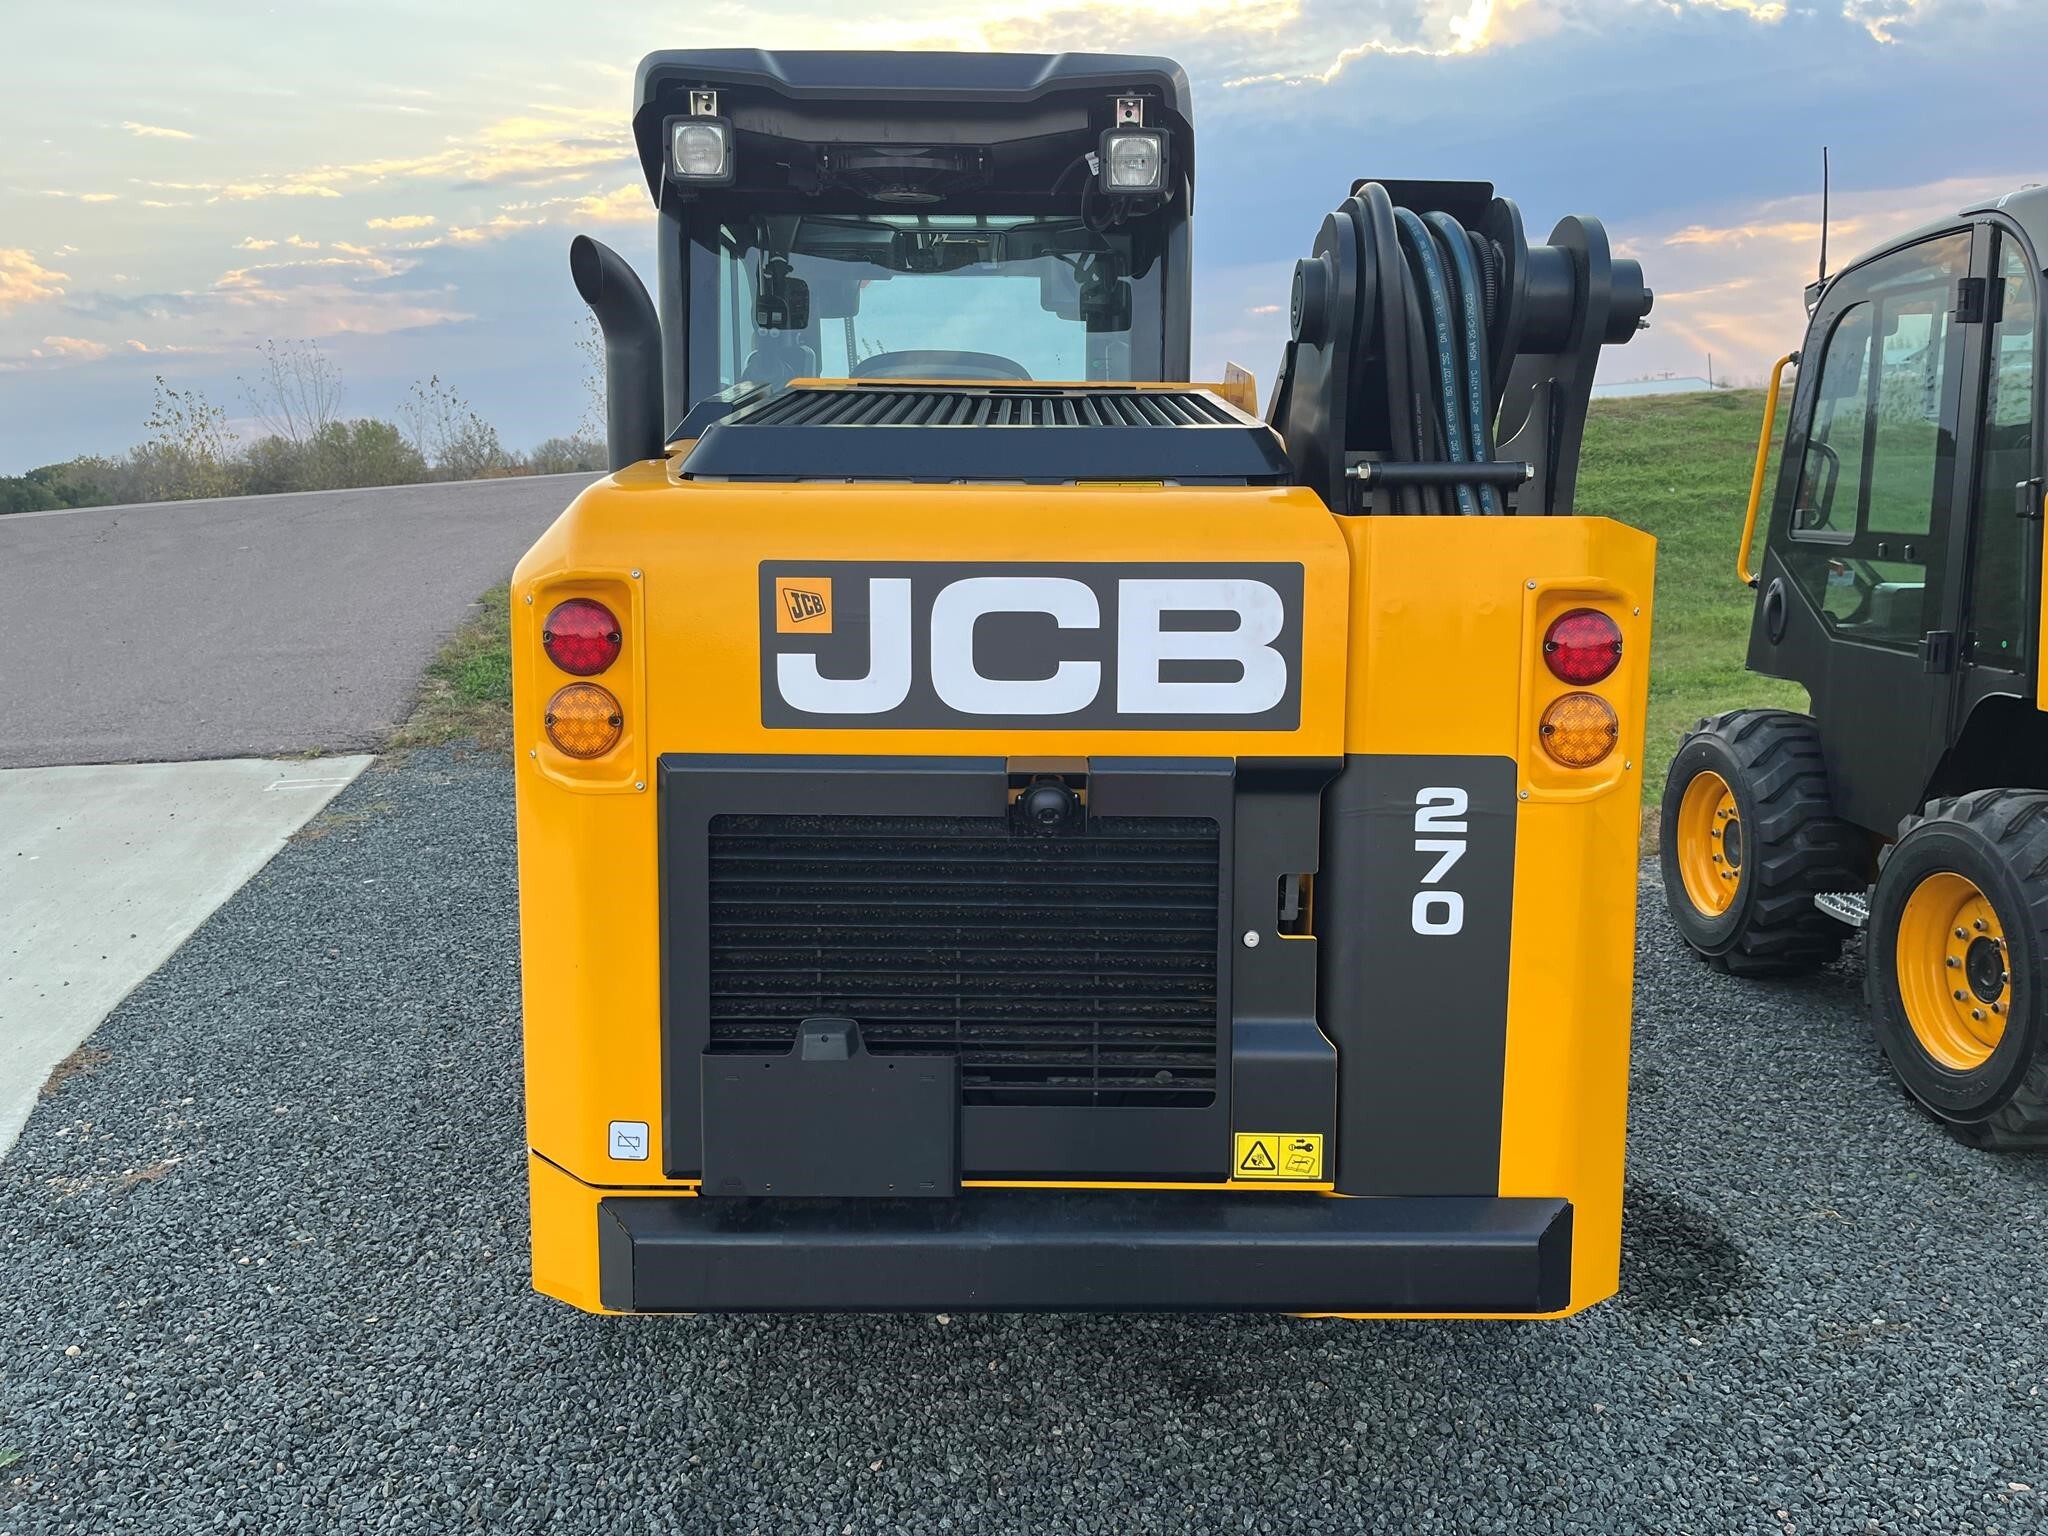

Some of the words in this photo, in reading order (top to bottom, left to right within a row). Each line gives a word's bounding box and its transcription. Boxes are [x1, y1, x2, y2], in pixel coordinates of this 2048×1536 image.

[1440, 332, 1447, 343] DN
[1445, 385, 1453, 397] ISO
[1448, 423, 1457, 436] SAE
[790, 592, 824, 619] JCB
[776, 576, 1288, 715] JCB
[1411, 787, 1468, 935] 270
